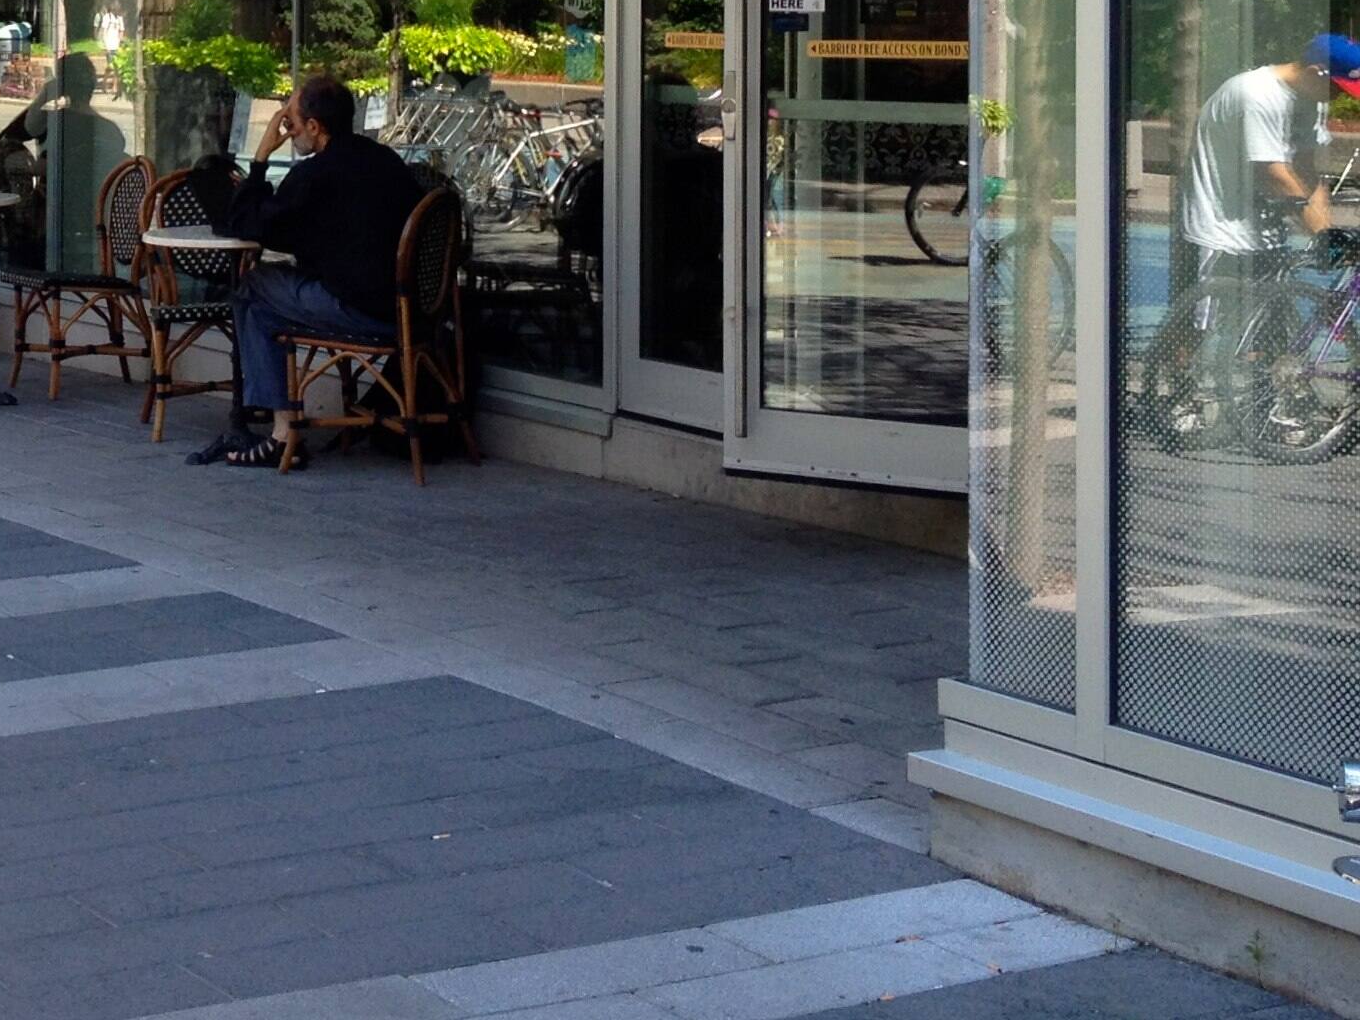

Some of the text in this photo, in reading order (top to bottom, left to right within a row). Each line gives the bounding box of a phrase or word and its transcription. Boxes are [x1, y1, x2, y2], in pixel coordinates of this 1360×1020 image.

[818, 43, 857, 55] BARRIER
[858, 43, 880, 55] FREE
[882, 43, 918, 56] ACCESS
[919, 43, 932, 56] ON
[934, 44, 961, 56] BOND
